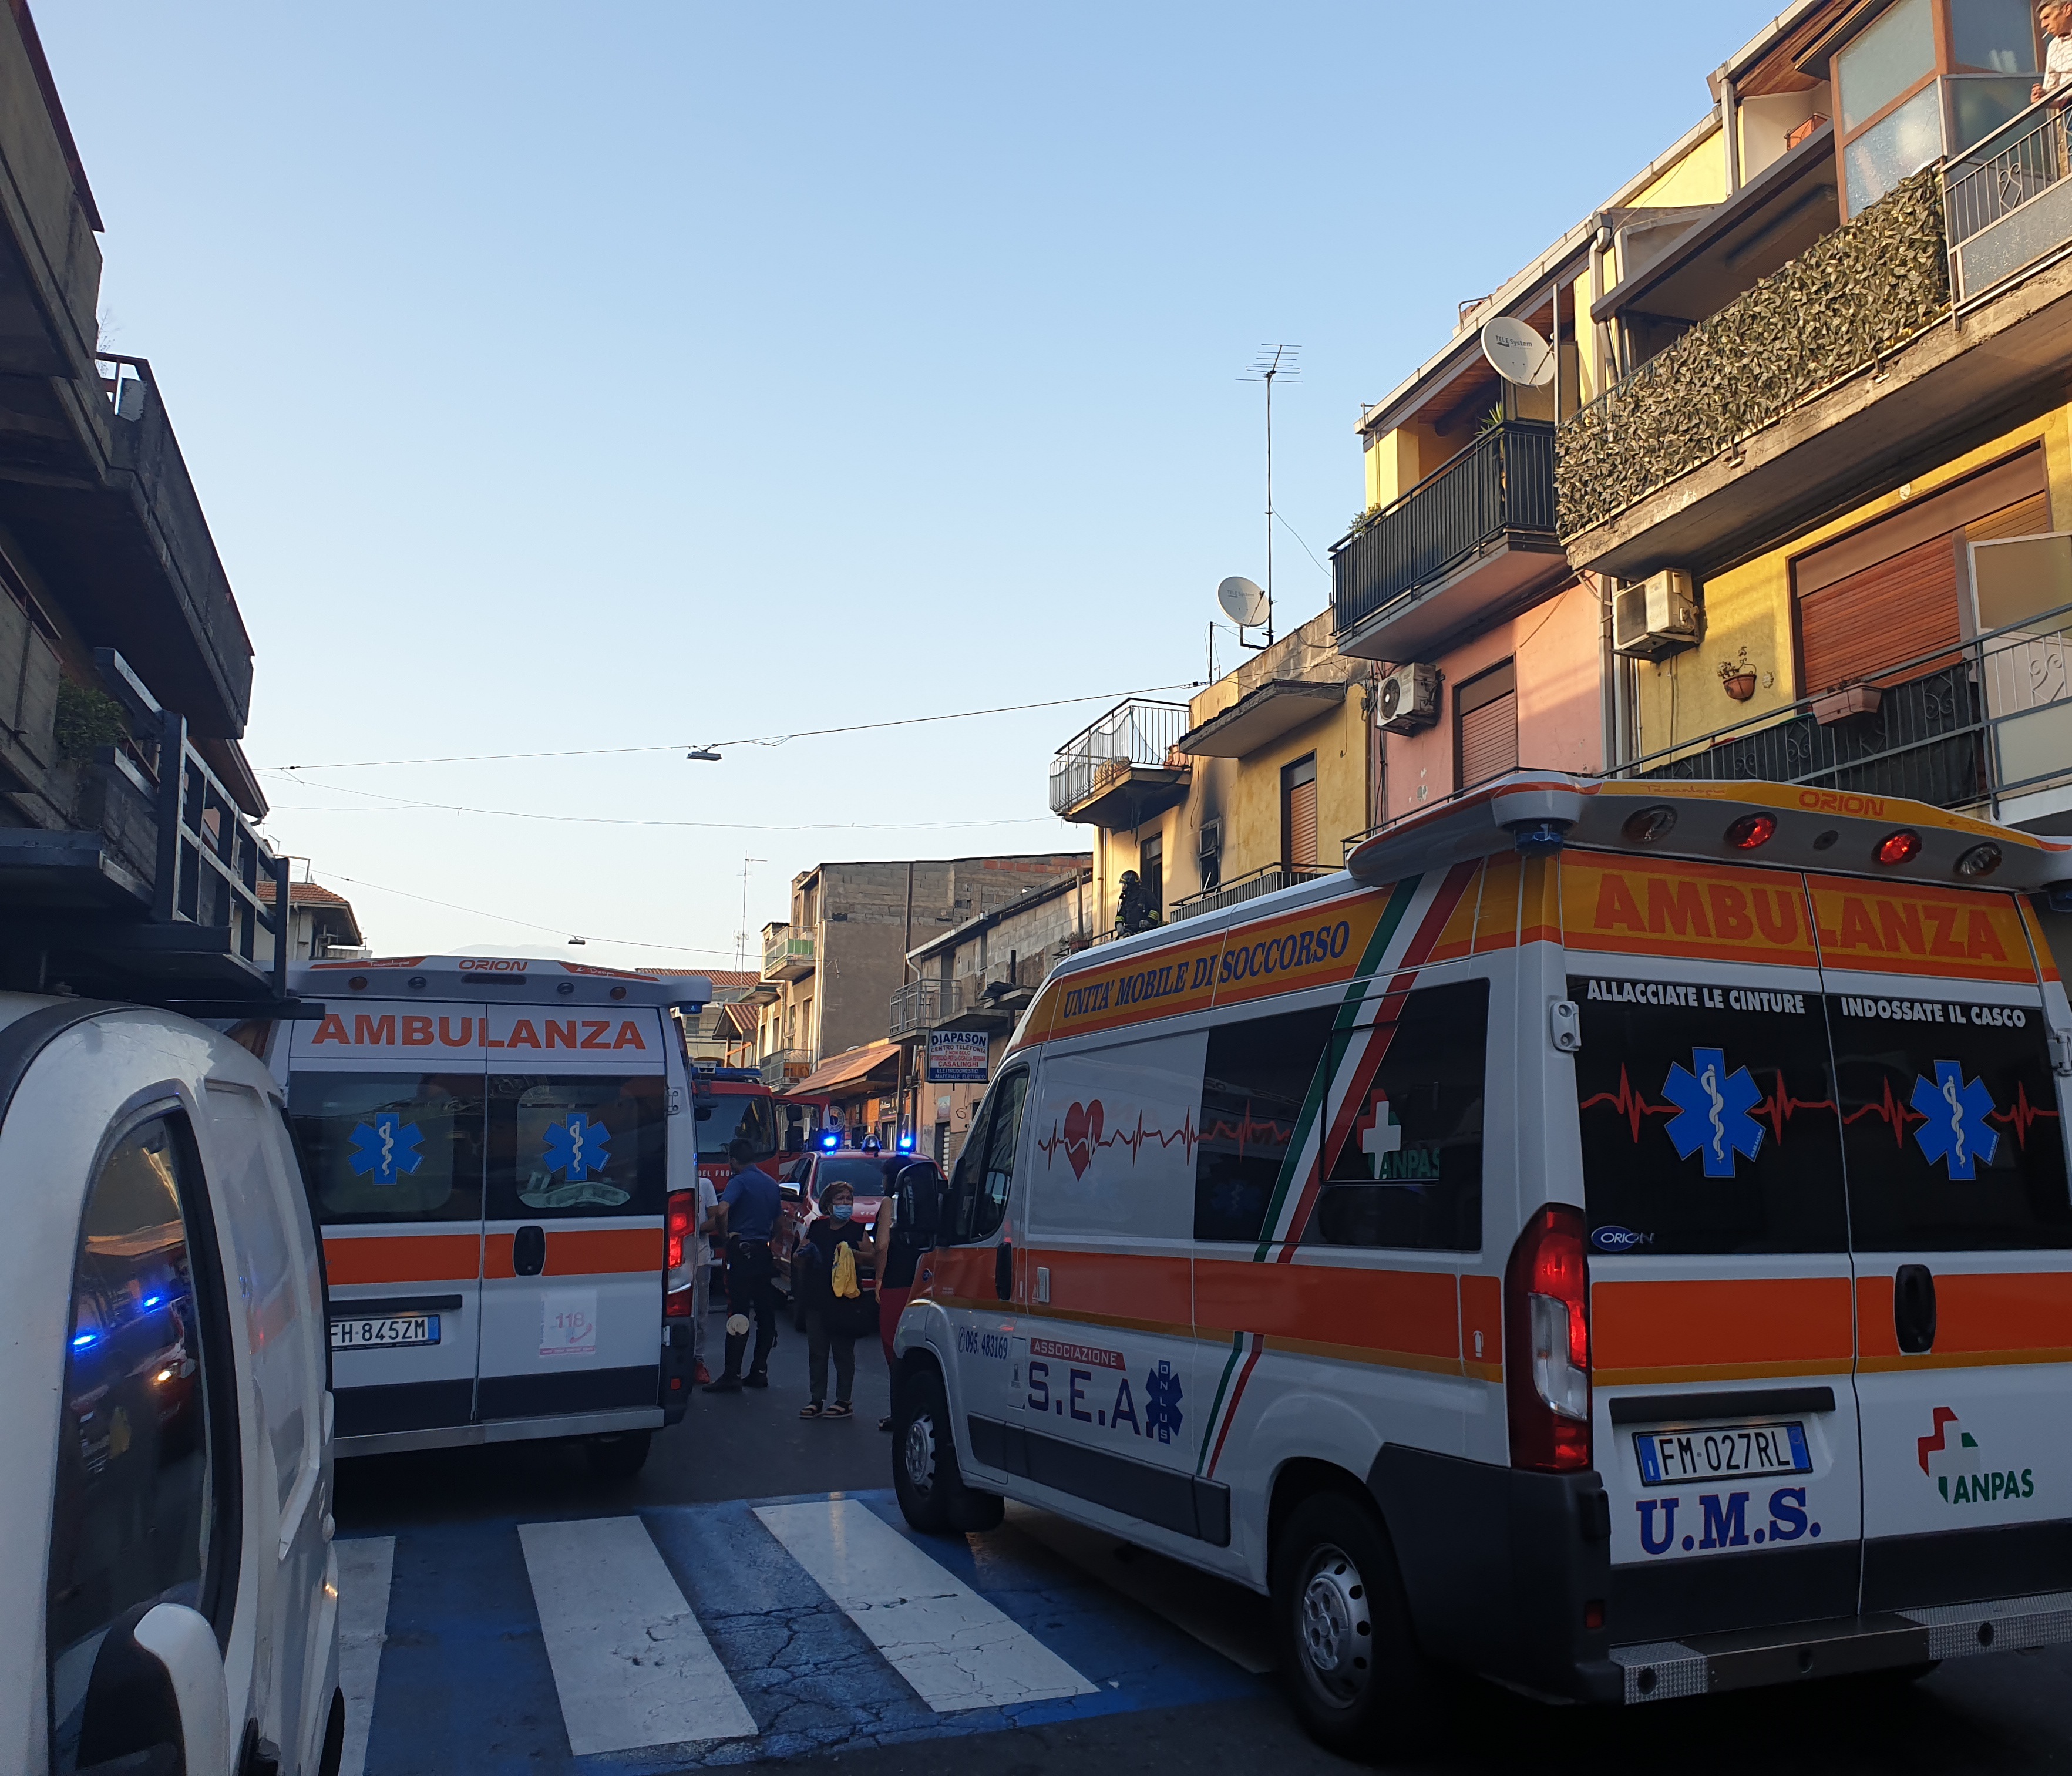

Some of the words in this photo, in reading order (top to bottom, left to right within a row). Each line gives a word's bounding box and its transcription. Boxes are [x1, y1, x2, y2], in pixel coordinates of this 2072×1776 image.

[1799, 791, 1885, 816] ORION
[1593, 873, 2007, 961] AMBULANZA
[459, 959, 527, 971] ORION
[1115, 961, 1189, 1007] MOBILE
[1190, 954, 1218, 990] DI
[1219, 920, 1350, 984] SOCCORSO
[1587, 980, 1698, 1007] ALLACCIATE
[1703, 988, 1724, 1008] LE
[1729, 990, 1805, 1014] CINTURE
[1841, 997, 1944, 1022] INDOSSATE
[1949, 1005, 1966, 1024] IL
[1971, 1007, 2026, 1028] CASCO
[311, 1014, 646, 1050] AMBULANZA
[931, 1033, 986, 1046] DIAPASON
[956, 1045, 986, 1054] TELEFONIA
[1379, 1147, 1440, 1179] ANPAS
[1600, 1232, 1655, 1244] ORION
[362, 1319, 425, 1342] 845ZM
[556, 1312, 585, 1328] 118
[981, 1333, 1008, 1360] 483169
[1034, 1340, 1118, 1366] ASSOCIAZIONE
[1953, 1468, 2034, 1504] ANPAS
[1636, 1487, 1821, 1555] U.M.S.
